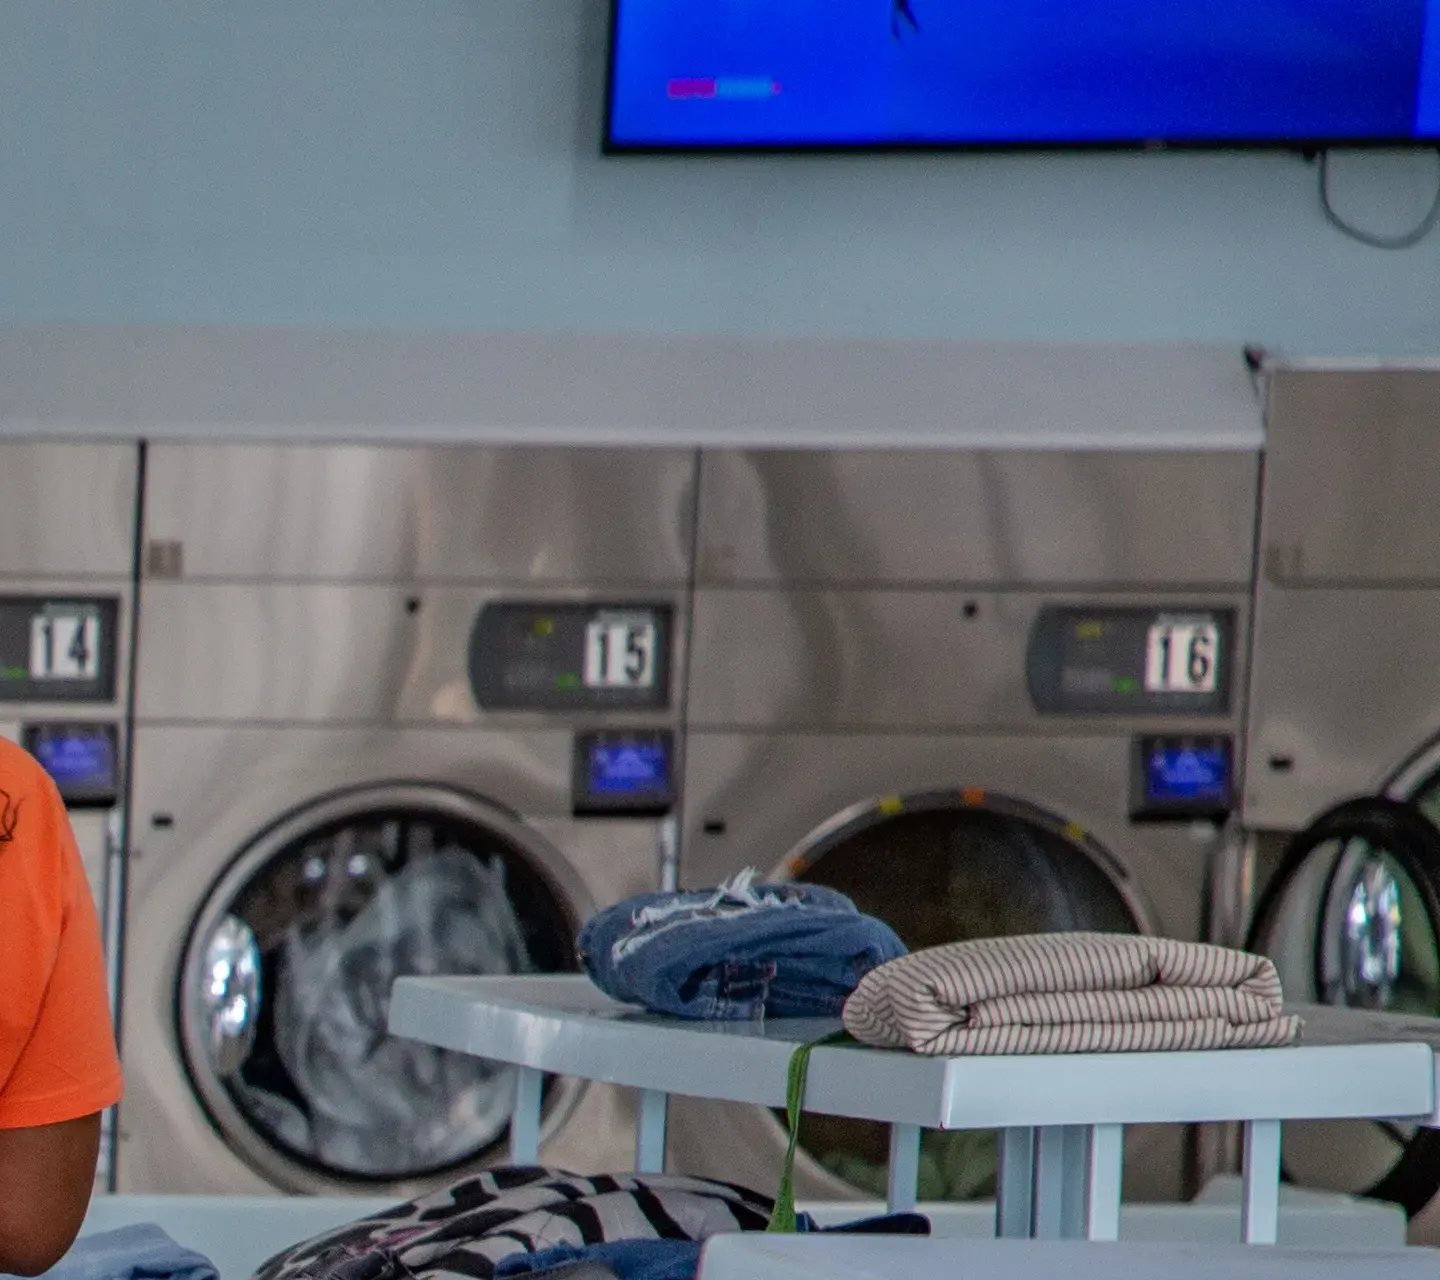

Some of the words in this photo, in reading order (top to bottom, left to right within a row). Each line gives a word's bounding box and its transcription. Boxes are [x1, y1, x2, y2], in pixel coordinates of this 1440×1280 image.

[42, 617, 88, 674] 14
[597, 626, 646, 681] 15
[1161, 630, 1209, 685] 16
